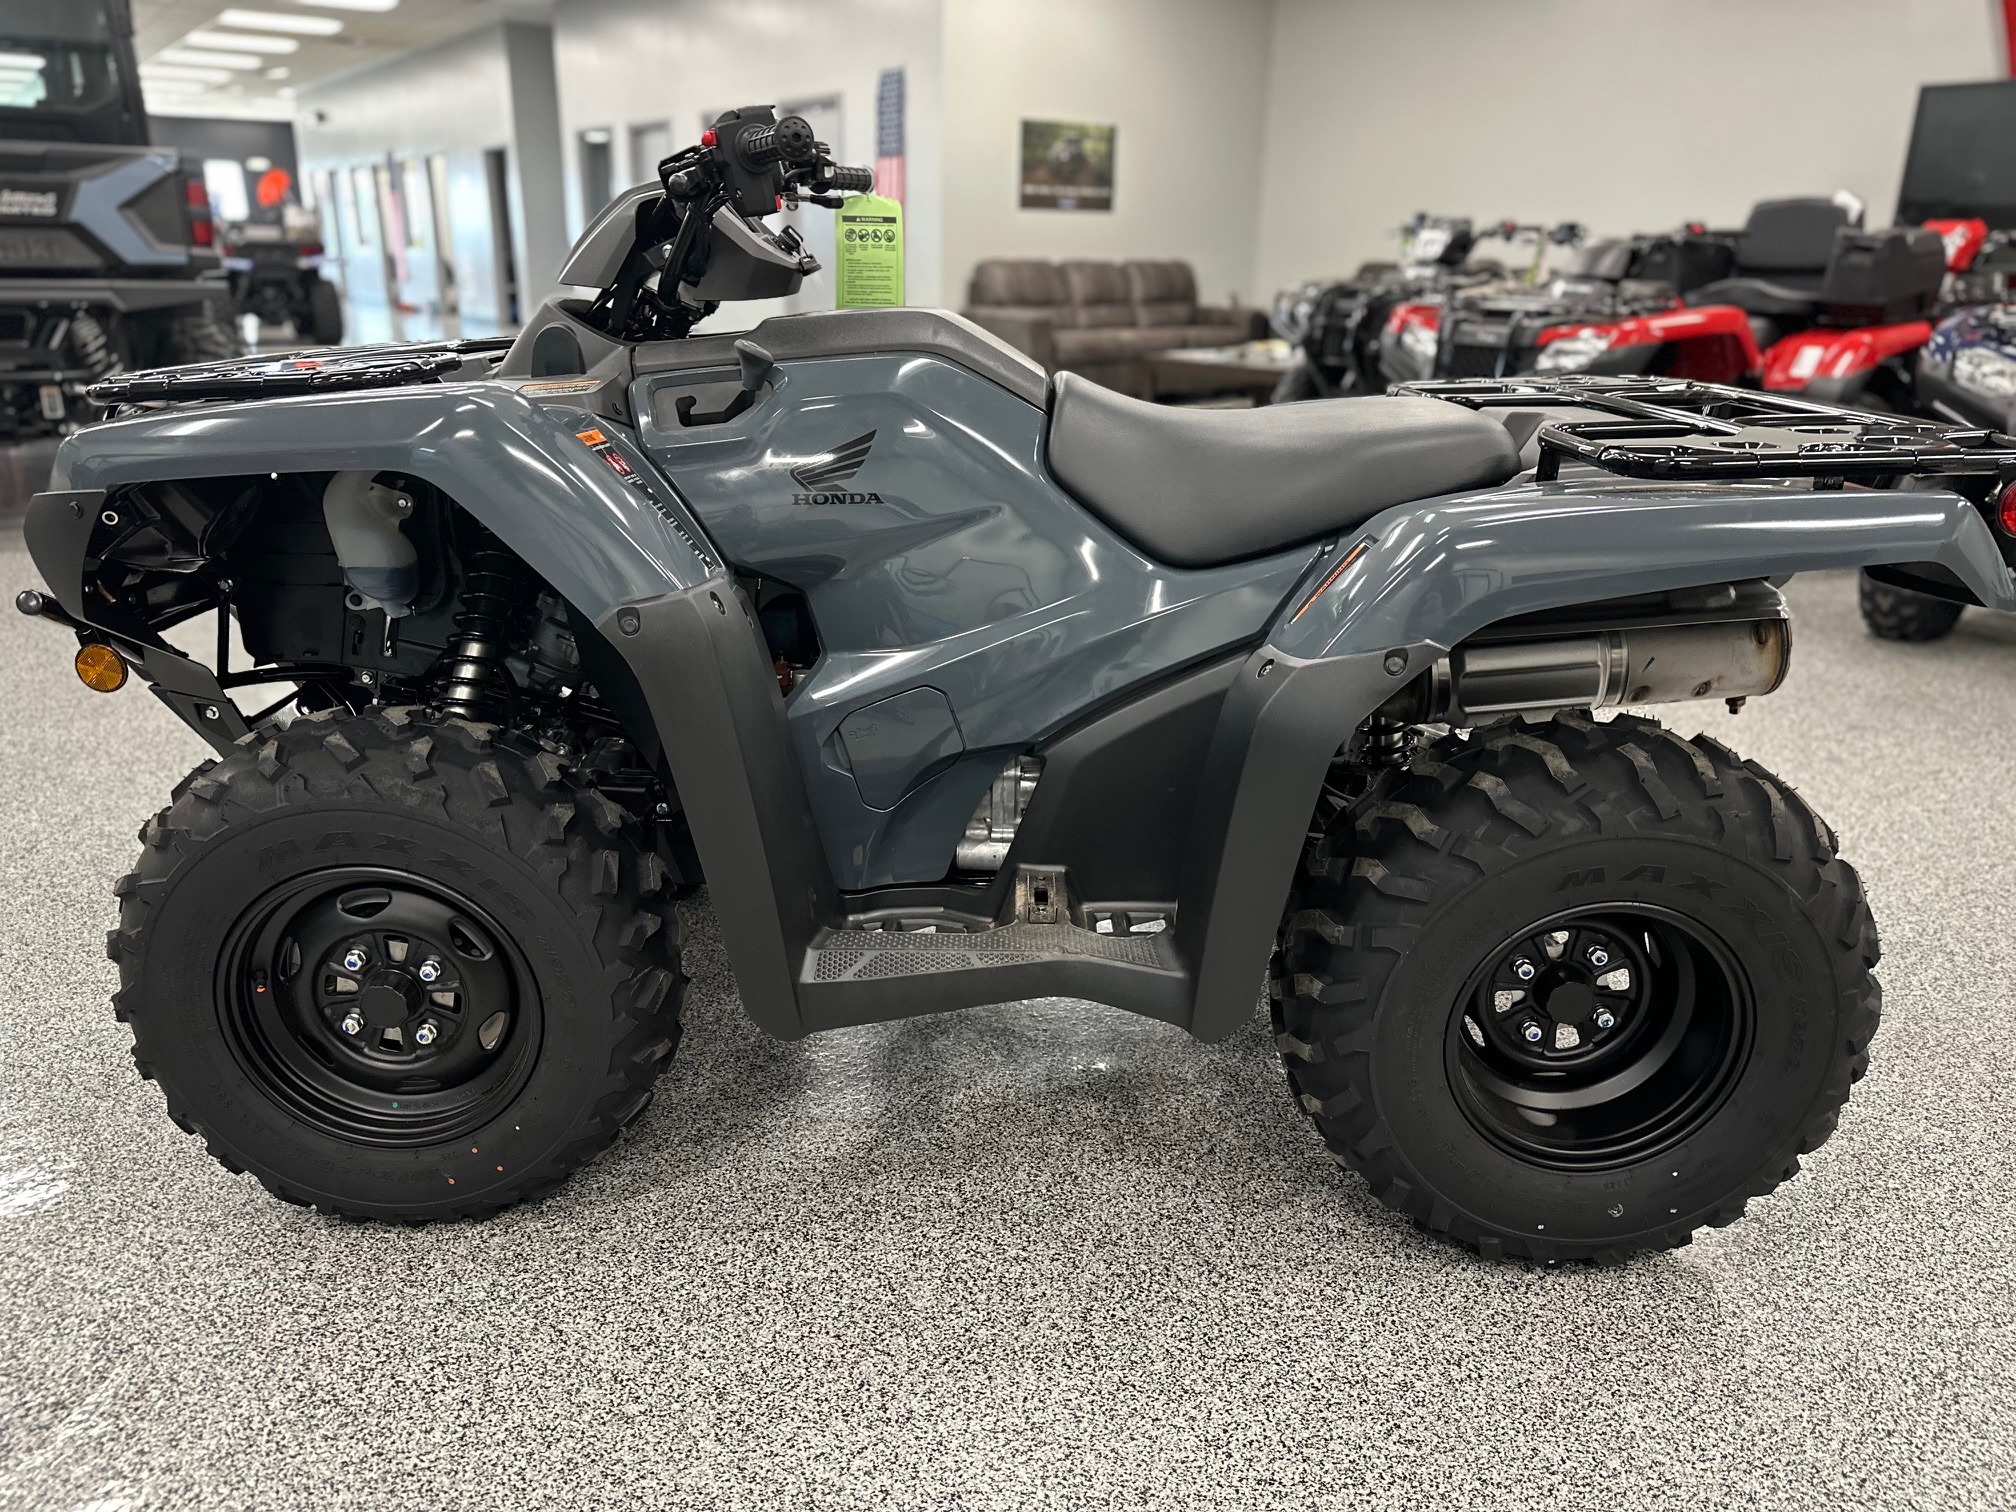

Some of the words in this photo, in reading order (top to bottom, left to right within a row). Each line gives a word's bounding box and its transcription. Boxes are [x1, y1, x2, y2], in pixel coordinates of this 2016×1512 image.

[792, 493, 884, 505] HONDA
[257, 831, 536, 922] MAXXIS
[1552, 864, 1804, 983] MAXXIS
